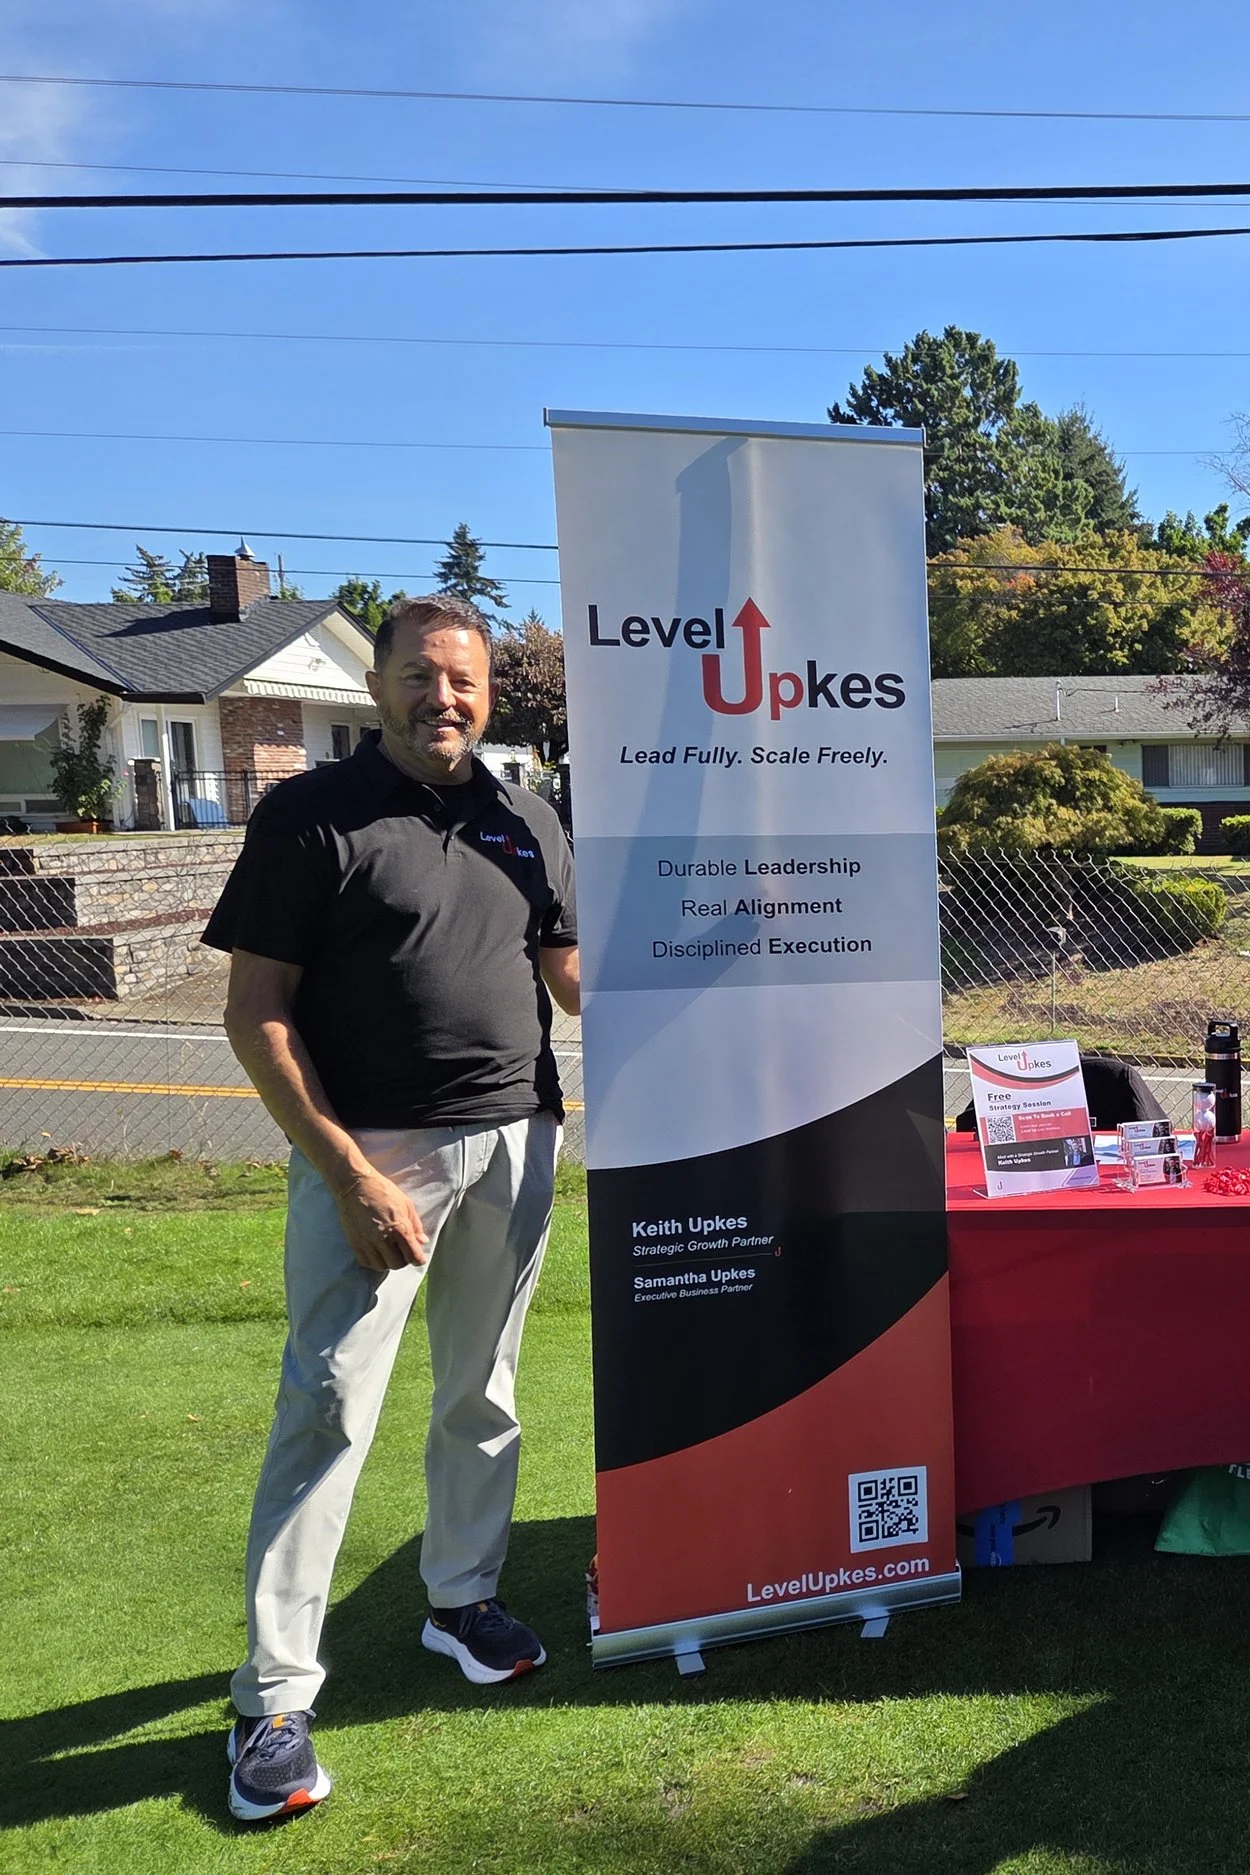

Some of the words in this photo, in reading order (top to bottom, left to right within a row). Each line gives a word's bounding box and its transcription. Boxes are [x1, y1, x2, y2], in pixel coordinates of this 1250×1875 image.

[588, 604, 725, 649] Level
[702, 620, 906, 720] Upkes
[620, 746, 676, 764] Lead
[683, 746, 742, 768] Fully.
[751, 747, 810, 764] Scale
[817, 747, 888, 768] Freely.
[480, 832, 505, 843] Level
[658, 859, 737, 877] Durable
[744, 858, 861, 878] Leadership
[681, 899, 727, 917] Real
[734, 898, 843, 919] Alignment
[652, 938, 761, 960] Disciplined
[768, 936, 872, 955] Execution
[998, 1052, 1021, 1062] Level
[1017, 1054, 1052, 1072] Upkes
[987, 1092, 1012, 1102] Free
[988, 1103, 1021, 1112] Strategy
[1022, 1100, 1052, 1109] Session
[1013, 1157, 1031, 1165] Upkes
[632, 1219, 683, 1238] Keith
[688, 1215, 748, 1235] Upkes
[632, 1242, 684, 1257] Strategic
[687, 1238, 729, 1252] Growth
[731, 1235, 774, 1248] Partner
[633, 1271, 707, 1289] Samantha
[710, 1267, 756, 1284] Upkes
[634, 1291, 677, 1303] Executive
[679, 1286, 719, 1298] Business
[720, 1283, 753, 1294] Partner
[747, 1556, 930, 1602] LevelUpkes.com
